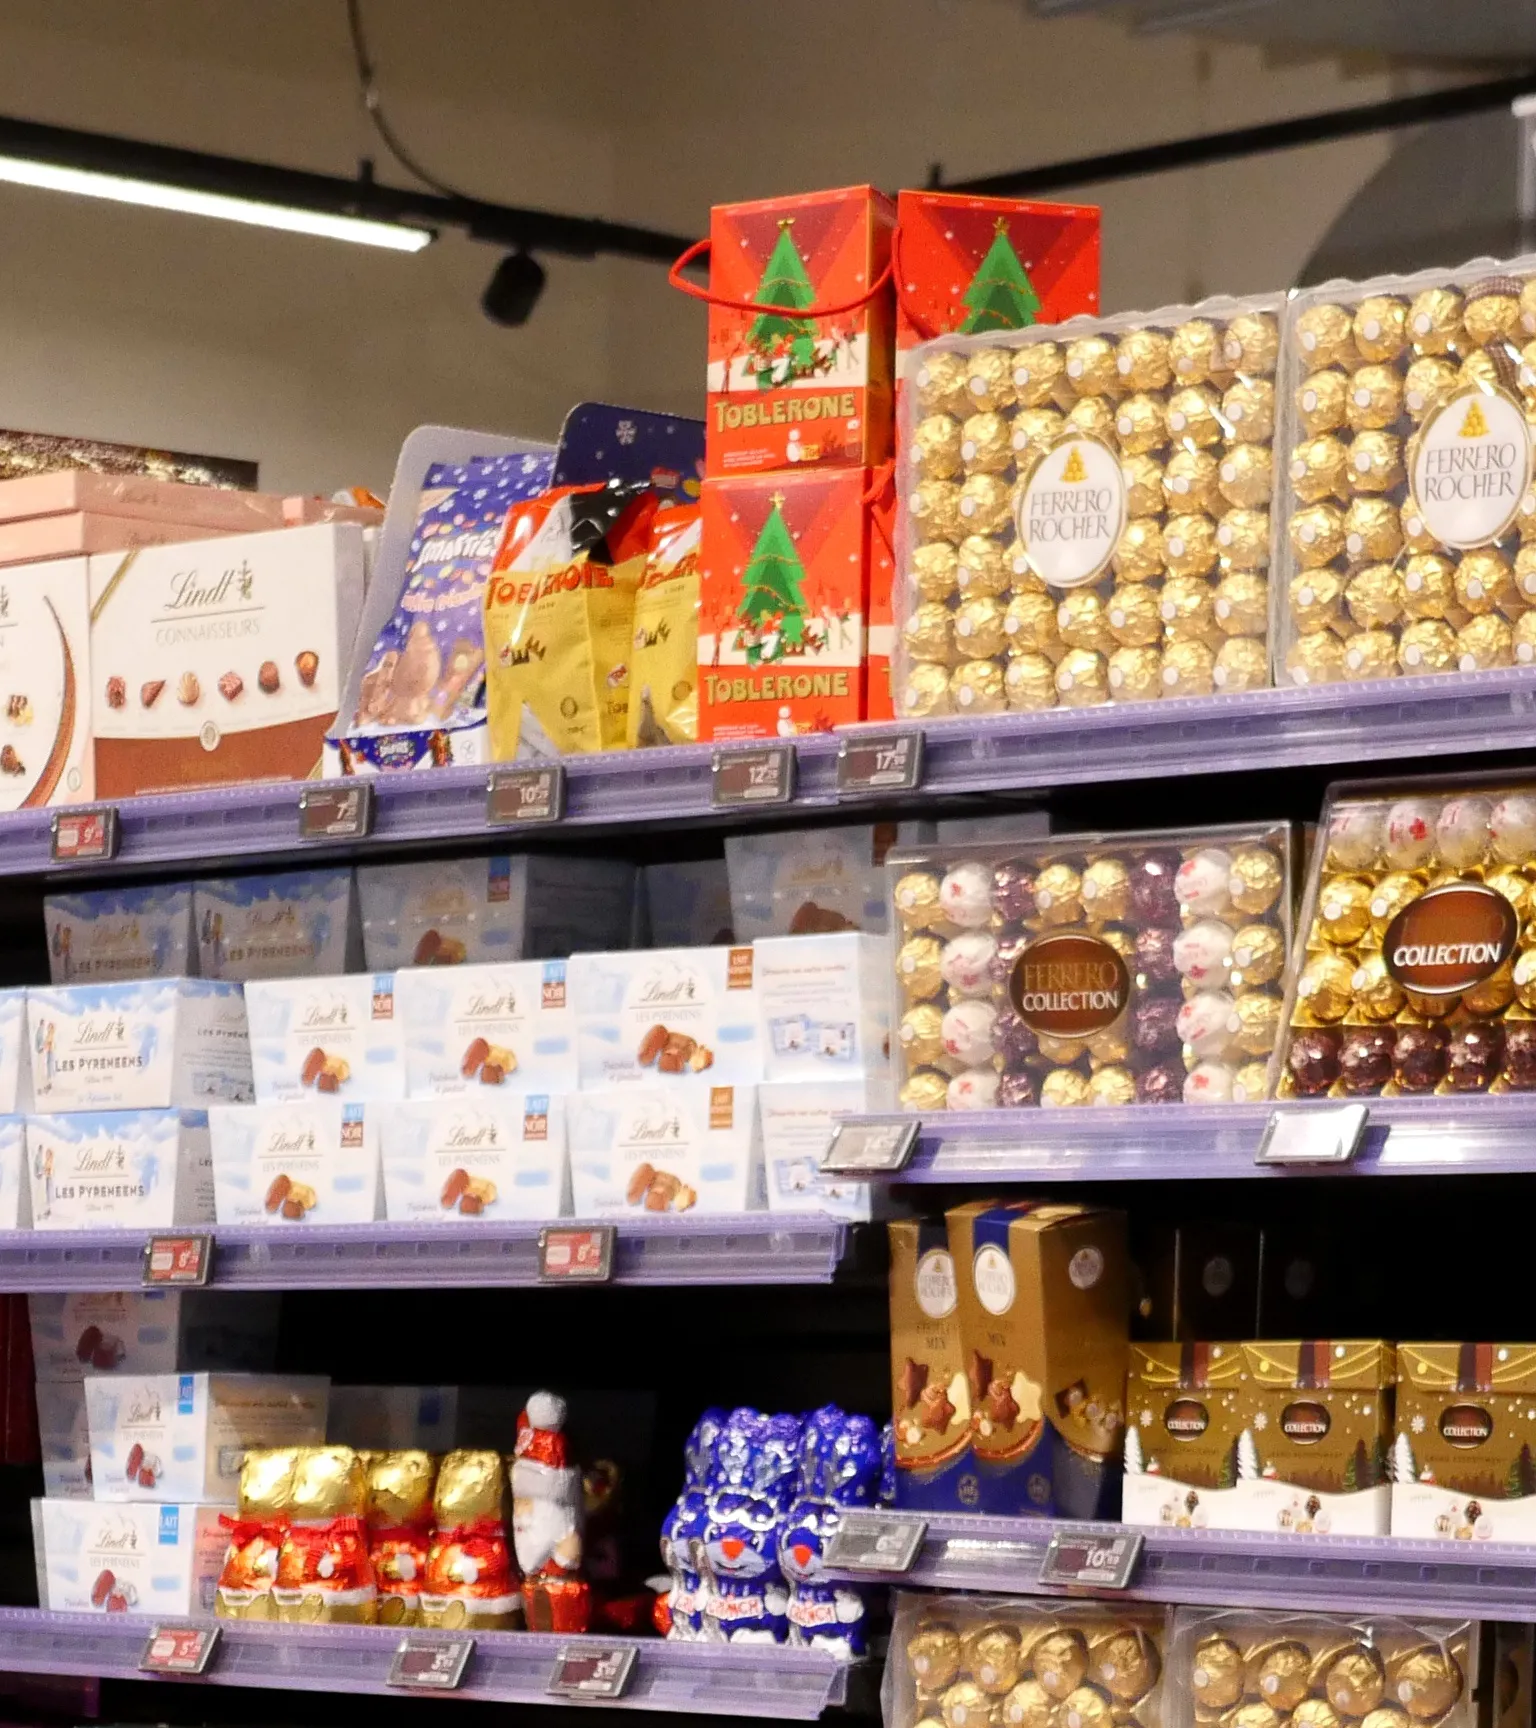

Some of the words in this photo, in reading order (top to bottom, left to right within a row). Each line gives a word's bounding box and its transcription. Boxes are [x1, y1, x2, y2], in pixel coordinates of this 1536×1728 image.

[715, 394, 855, 433] TOBLERONE
[1425, 442, 1516, 473] FERRERO
[1424, 473, 1514, 502] ROCHER
[1030, 489, 1113, 514] FERRERO
[1028, 515, 1111, 542] ROCHER
[163, 570, 236, 610] Lindt
[156, 618, 260, 646] CONNAISSEURS
[705, 673, 849, 705] TOBLERONE
[1393, 941, 1502, 967] COLLECTION
[1024, 961, 1118, 991] FERRERO
[642, 983, 683, 1002] Lindt
[1023, 988, 1119, 1012] COLLECTION
[303, 1006, 339, 1026] Lindt
[466, 996, 506, 1016] Lindt
[74, 1020, 114, 1044] Lindt
[55, 1060, 74, 1072] LES
[445, 1127, 483, 1147] Lindt
[629, 1120, 669, 1140] Lindt
[269, 1133, 305, 1152] Lindt
[74, 1148, 114, 1172] Lindt
[56, 1187, 75, 1200] LES
[1284, 1421, 1326, 1434] COLLECTION
[1443, 1423, 1489, 1439] COLLECTION
[95, 1529, 130, 1549] Lindt
